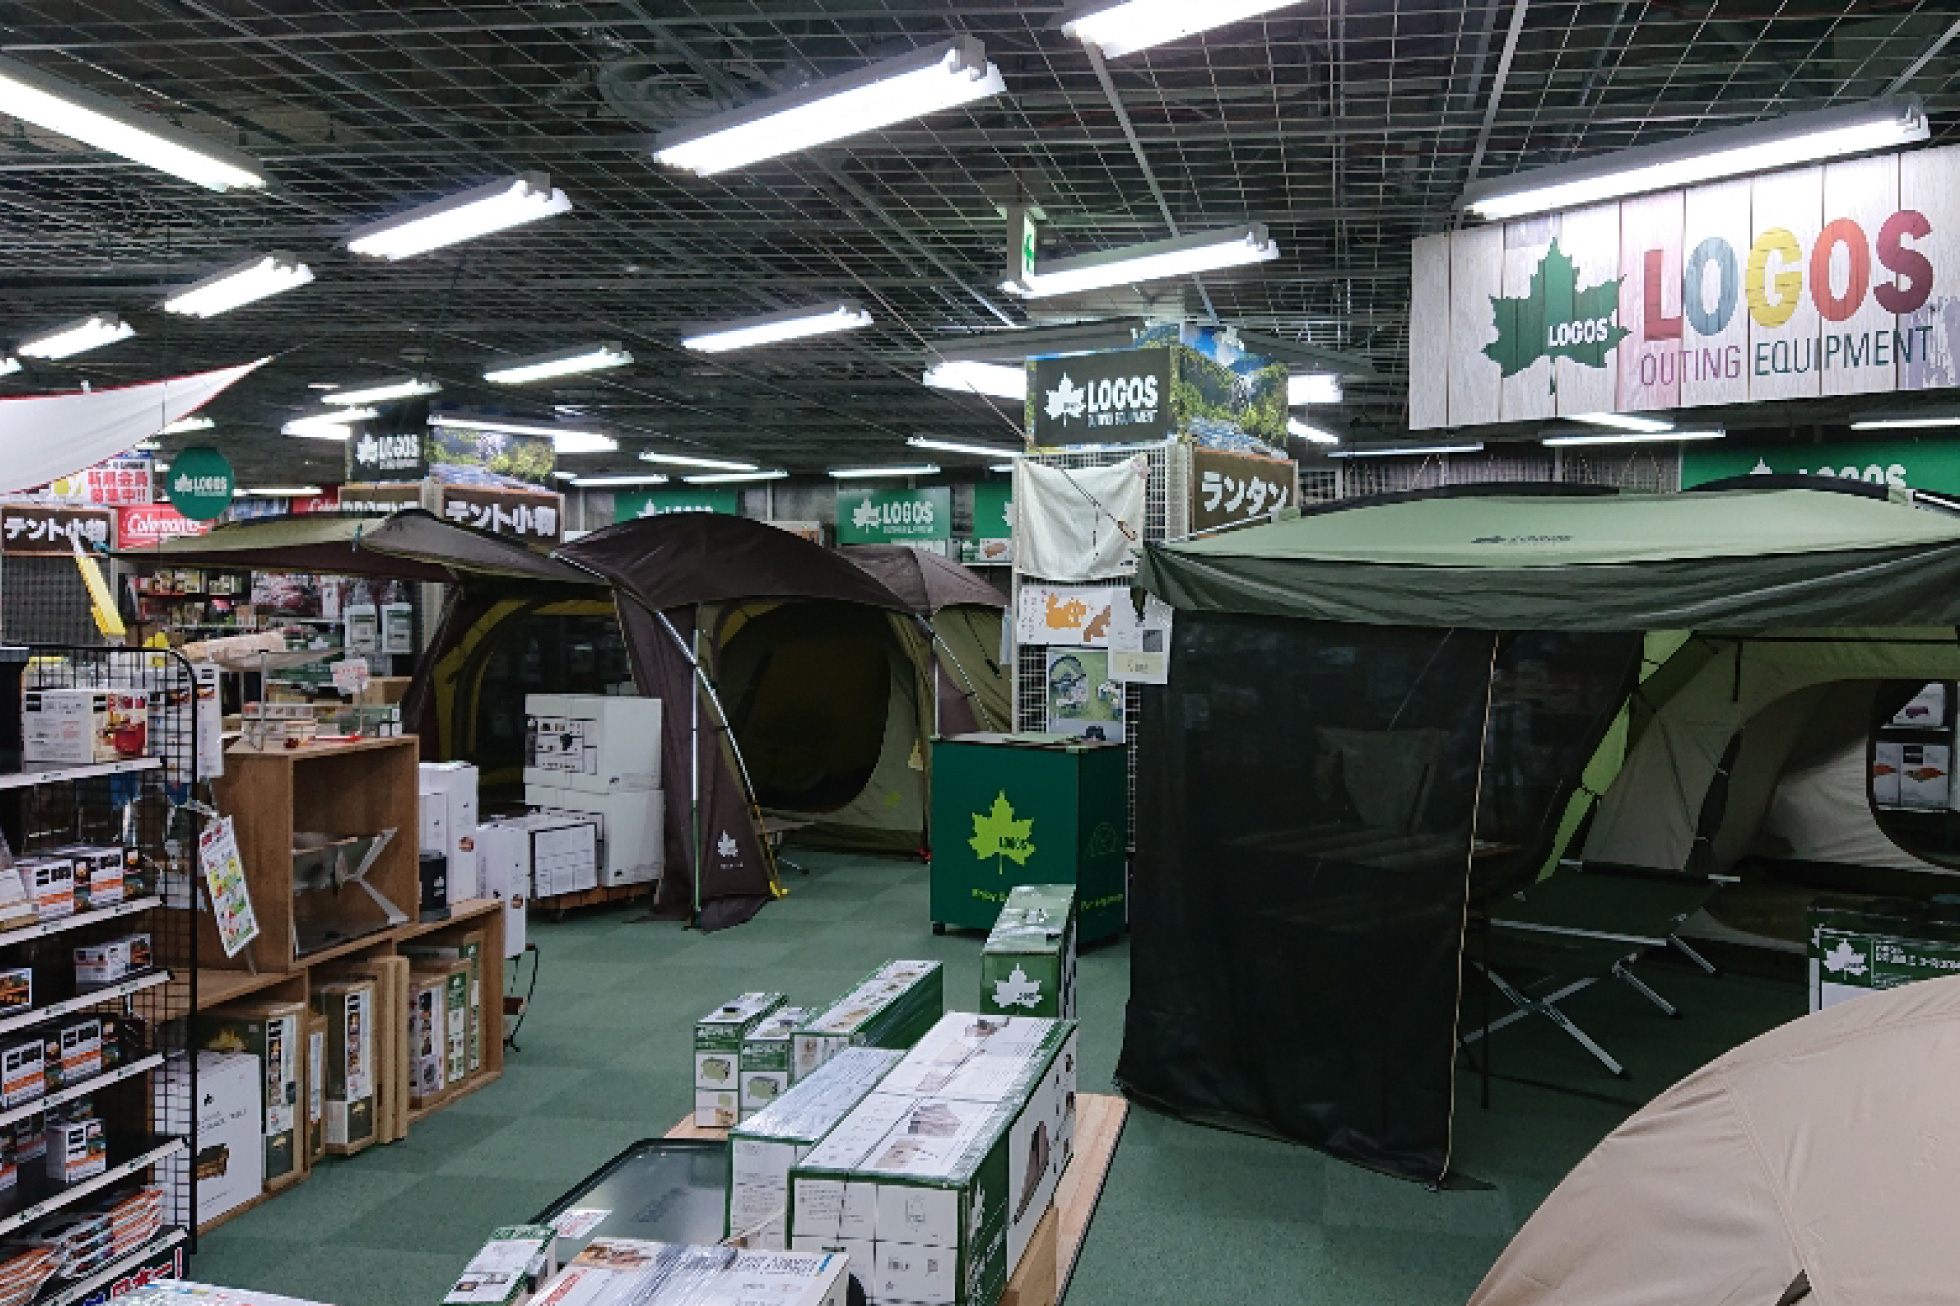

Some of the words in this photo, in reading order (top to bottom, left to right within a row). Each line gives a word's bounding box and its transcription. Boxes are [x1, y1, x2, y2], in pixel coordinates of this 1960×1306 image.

[1643, 209, 1934, 342] LOGOS
[1549, 318, 1609, 347] LOGOS
[1640, 345, 1742, 386] OUTING
[1754, 325, 1934, 376] EQUIPMENT
[1088, 374, 1159, 413] LOGOS
[882, 501, 934, 525] LOGOS
[1201, 470, 1288, 517] ランタン
